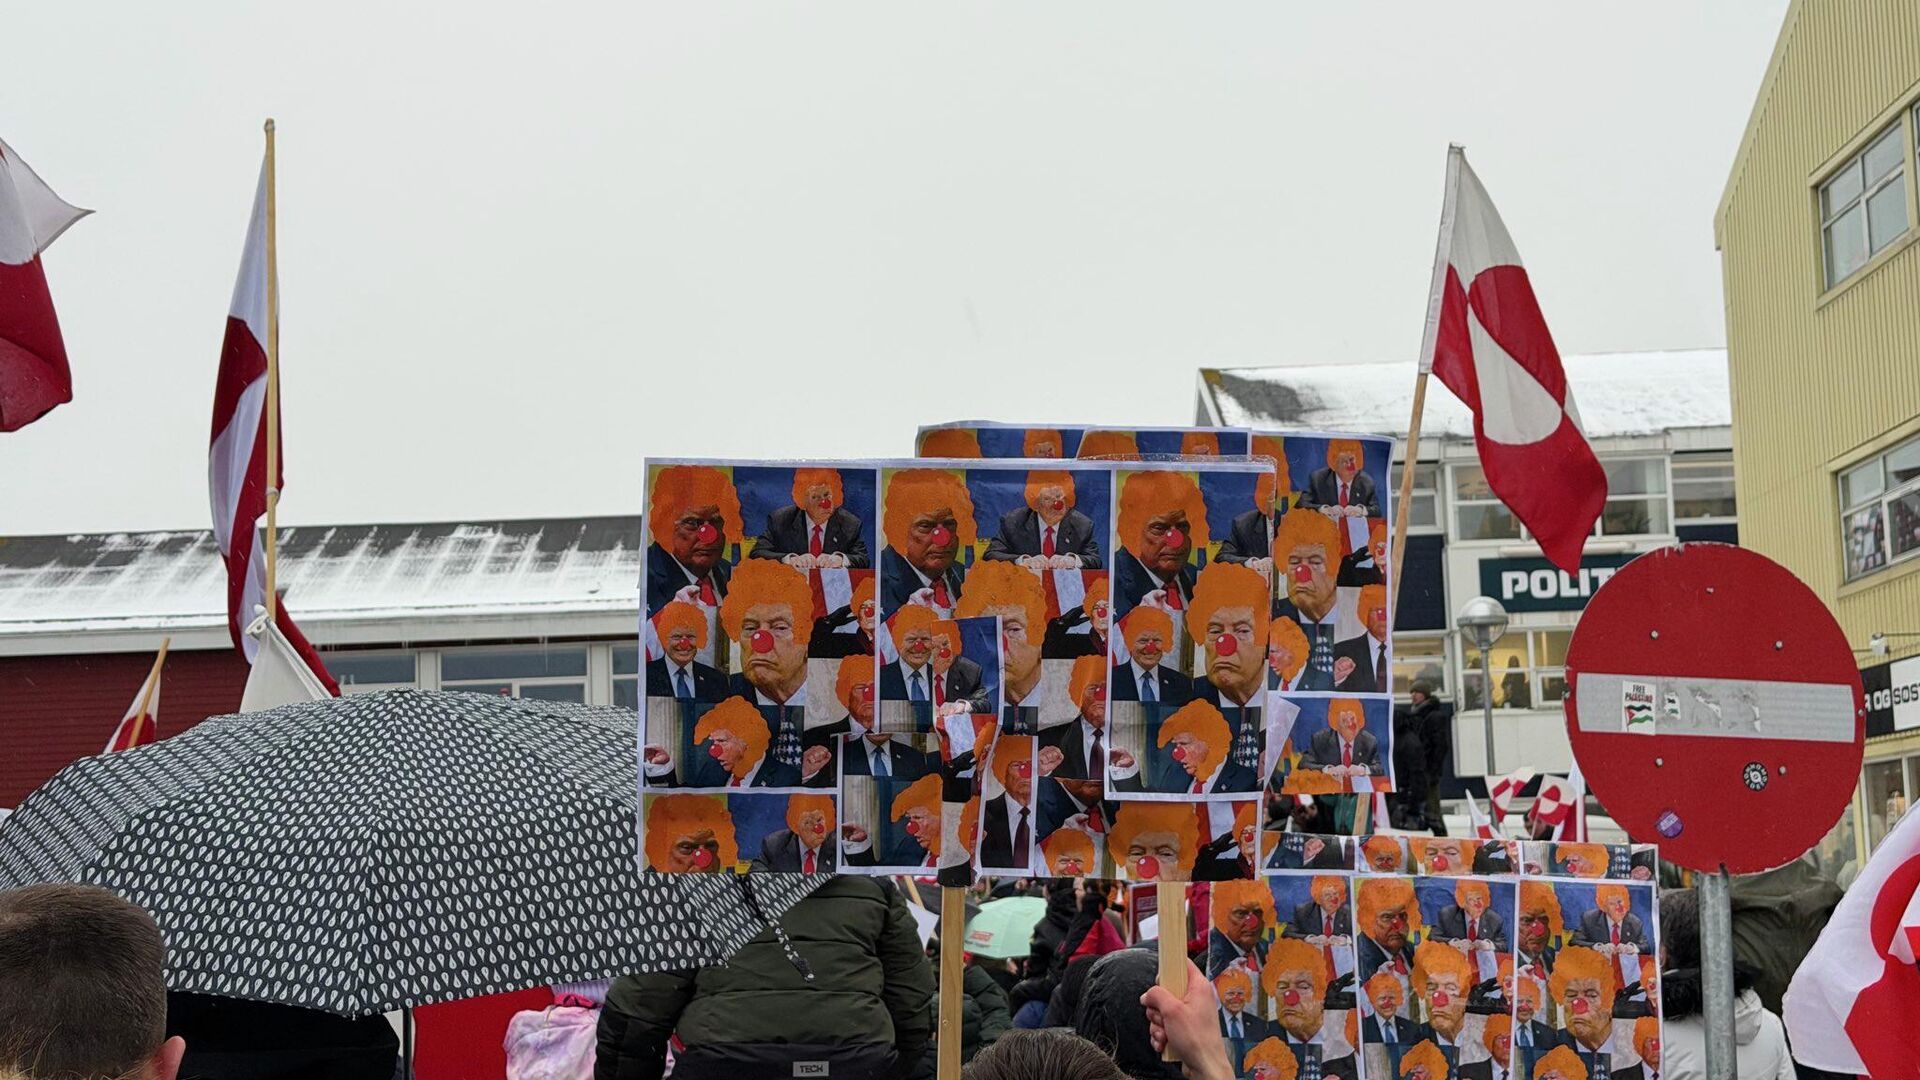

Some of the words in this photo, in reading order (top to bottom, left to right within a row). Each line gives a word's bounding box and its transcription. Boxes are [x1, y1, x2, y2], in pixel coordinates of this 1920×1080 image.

[1501, 567, 1620, 600] POLIT
[1873, 688, 1891, 711] OG
[1893, 683, 1920, 705] SOS
